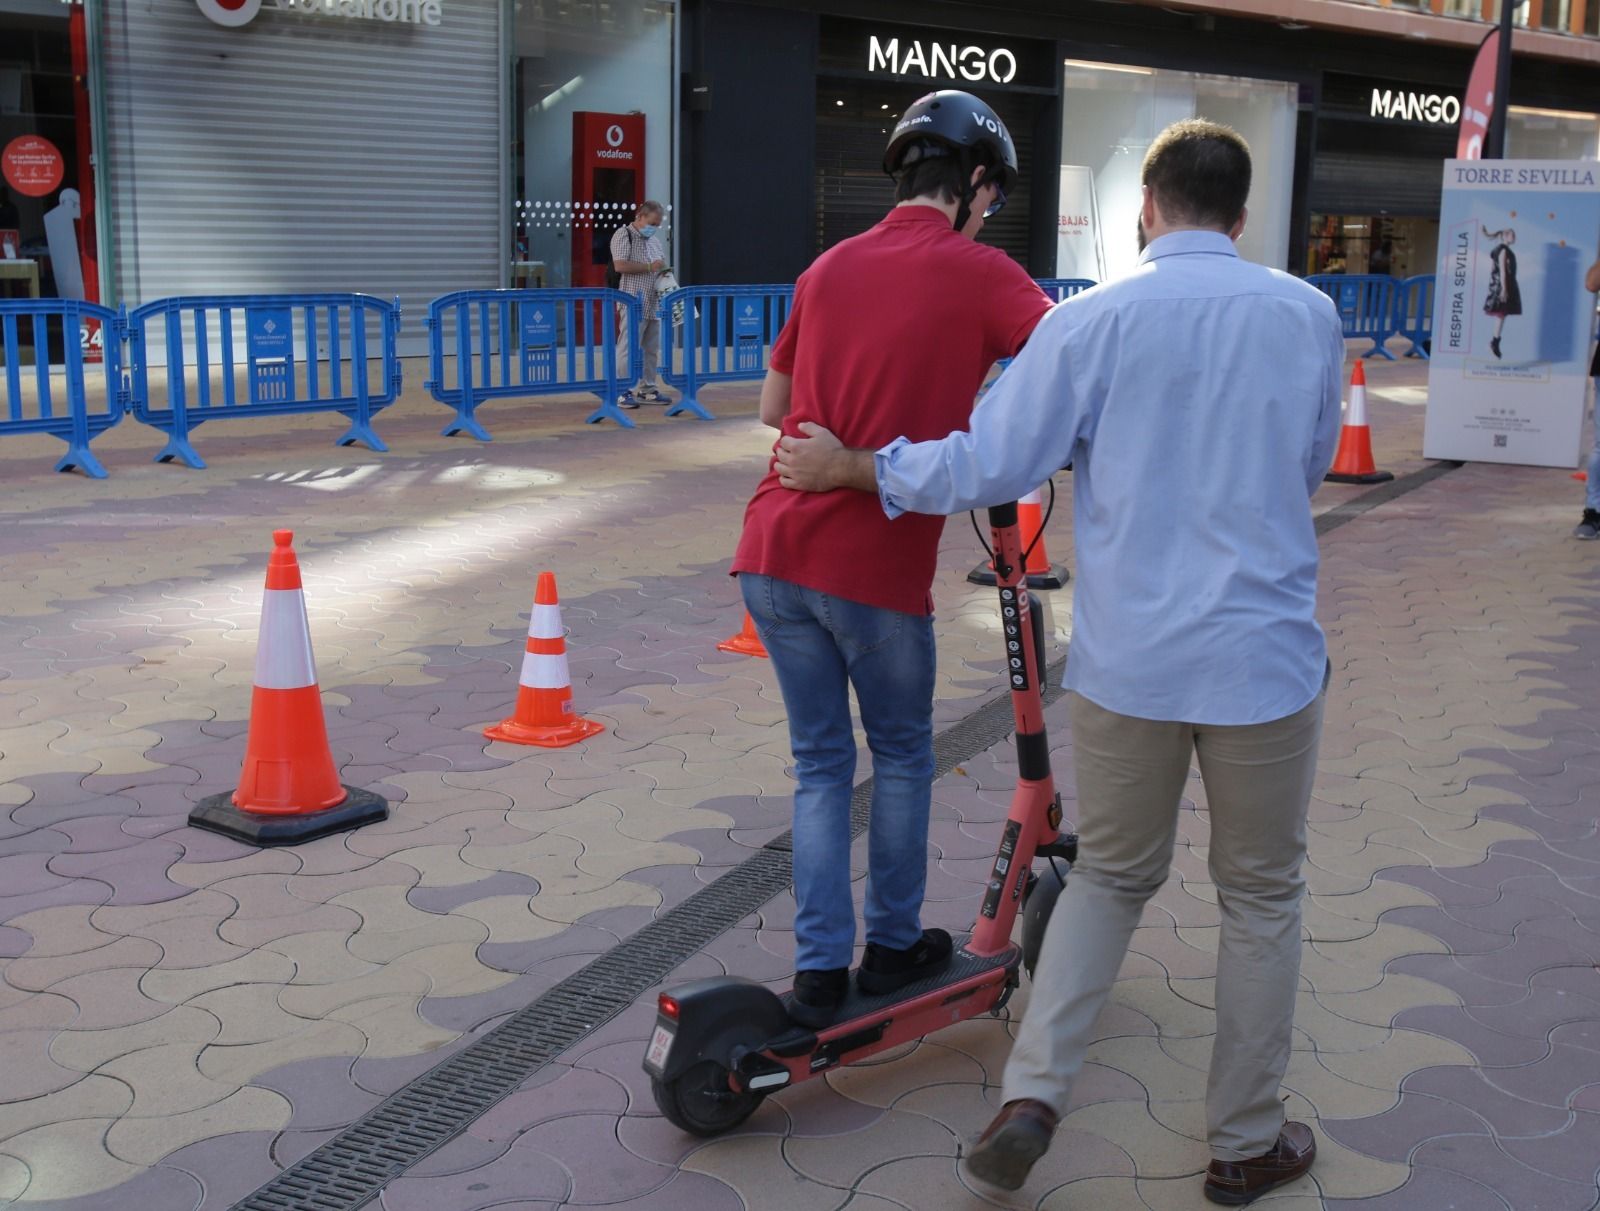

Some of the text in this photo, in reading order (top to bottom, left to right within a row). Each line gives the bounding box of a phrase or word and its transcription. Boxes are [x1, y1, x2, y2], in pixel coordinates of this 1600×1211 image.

[868, 35, 1017, 84] MANGO
[1370, 88, 1461, 124] MANGO
[911, 114, 932, 125] safe.
[972, 111, 1008, 142] voi.
[596, 149, 633, 160] vodafone
[1455, 168, 1594, 185] TORRE SEVILLA
[1057, 215, 1089, 226] EBAJAS
[1449, 231, 1469, 348] RESPIRA SEVILLA
[79, 328, 103, 348] 24
